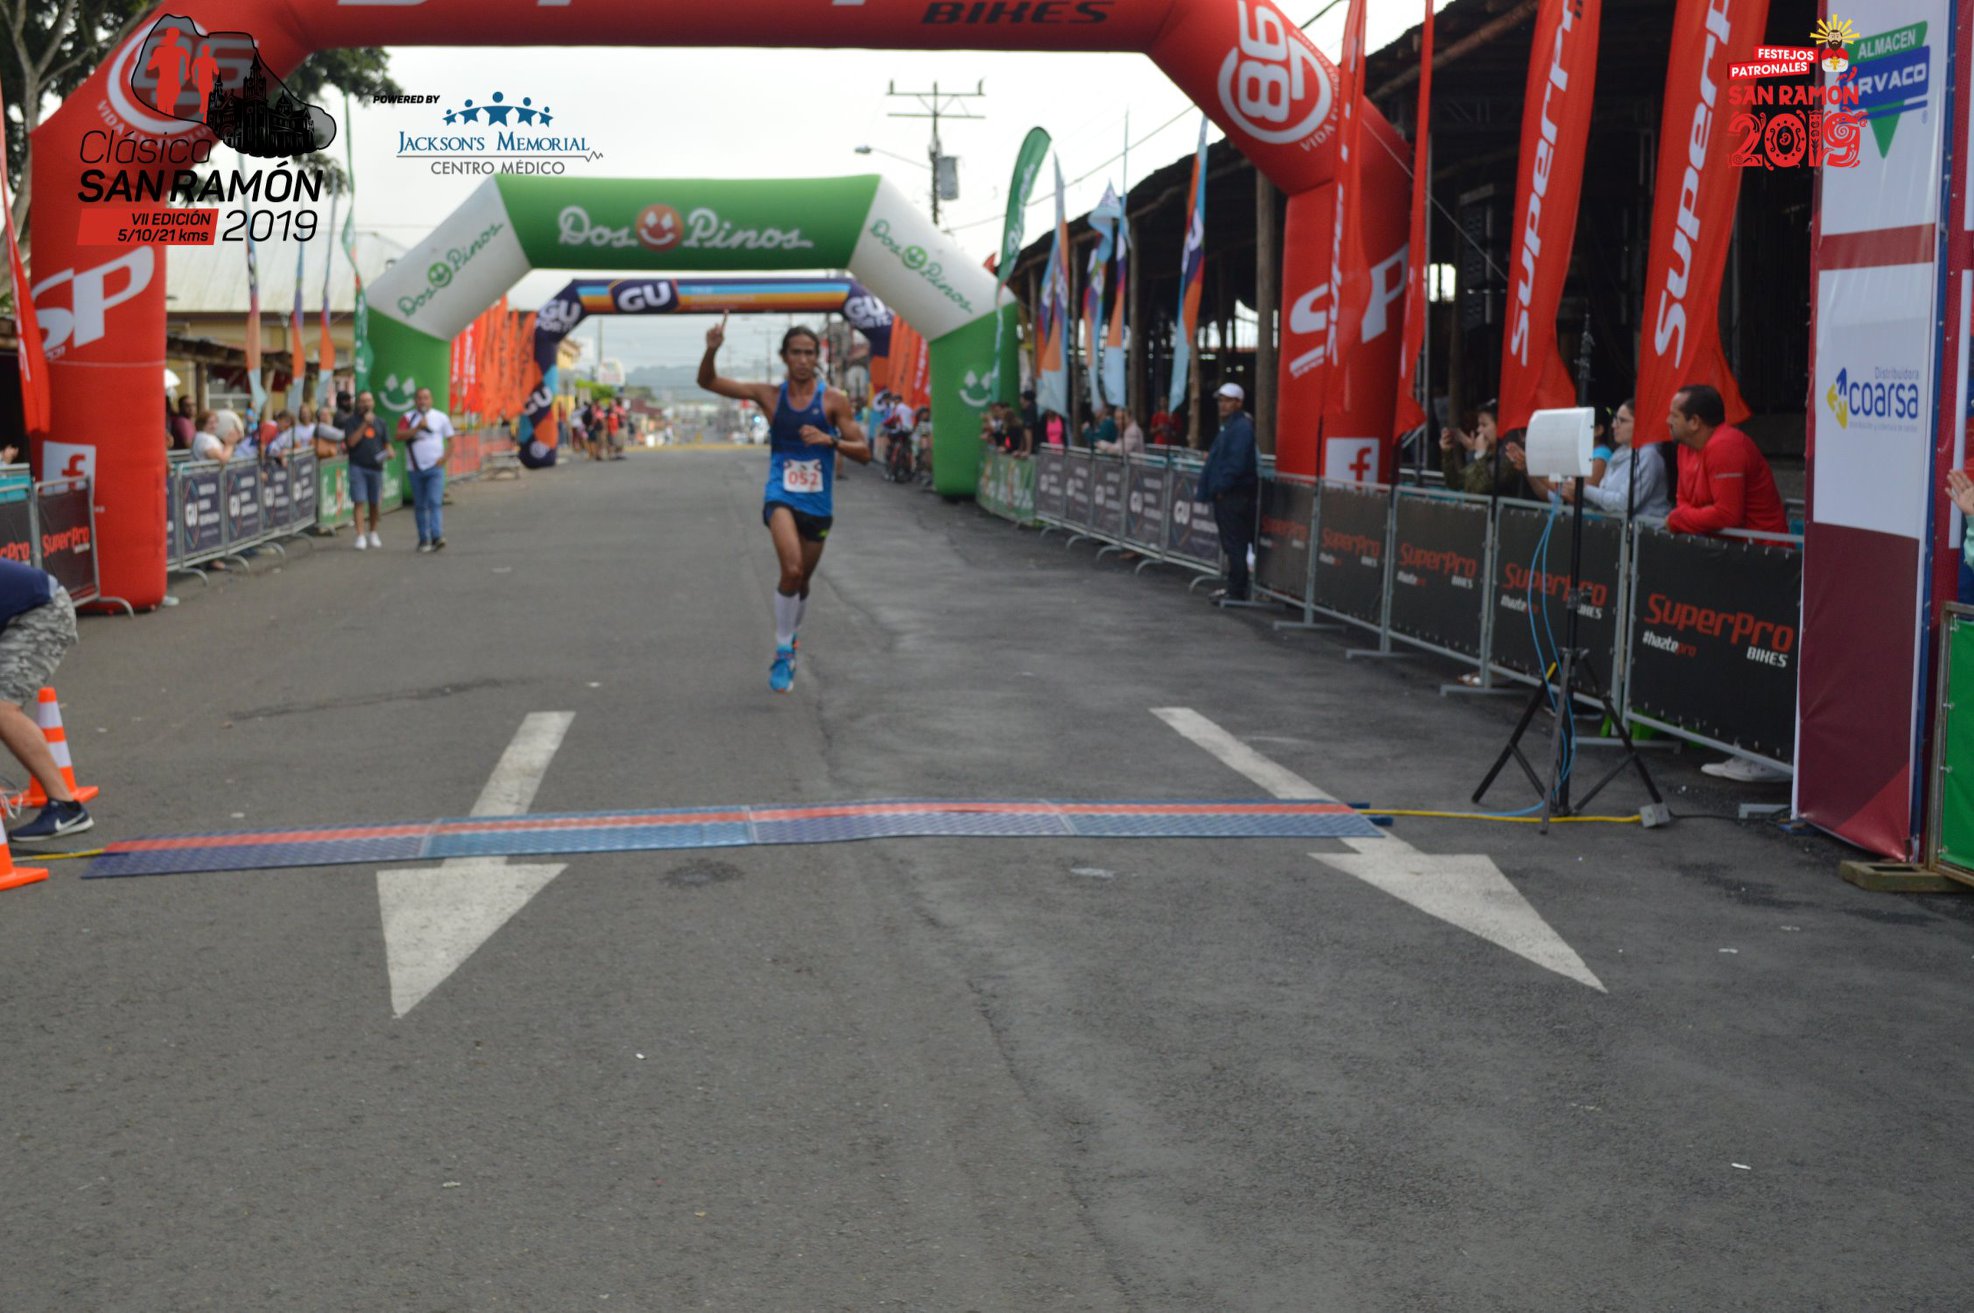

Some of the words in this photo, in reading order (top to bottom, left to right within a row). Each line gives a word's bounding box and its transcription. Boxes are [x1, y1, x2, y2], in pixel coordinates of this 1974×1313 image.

[921, 1, 1112, 24] BIKES
[1857, 28, 1916, 59] ALMACEN
[558, 205, 638, 248] Dos
[682, 207, 814, 249] Pinos
[538, 299, 582, 322] GU
[617, 281, 672, 313] GU
[1849, 381, 1919, 419] coarsa
[1398, 542, 1477, 579] SuperPro
[1644, 593, 1794, 653] SuperPro
[1746, 645, 1789, 668] BIKES
